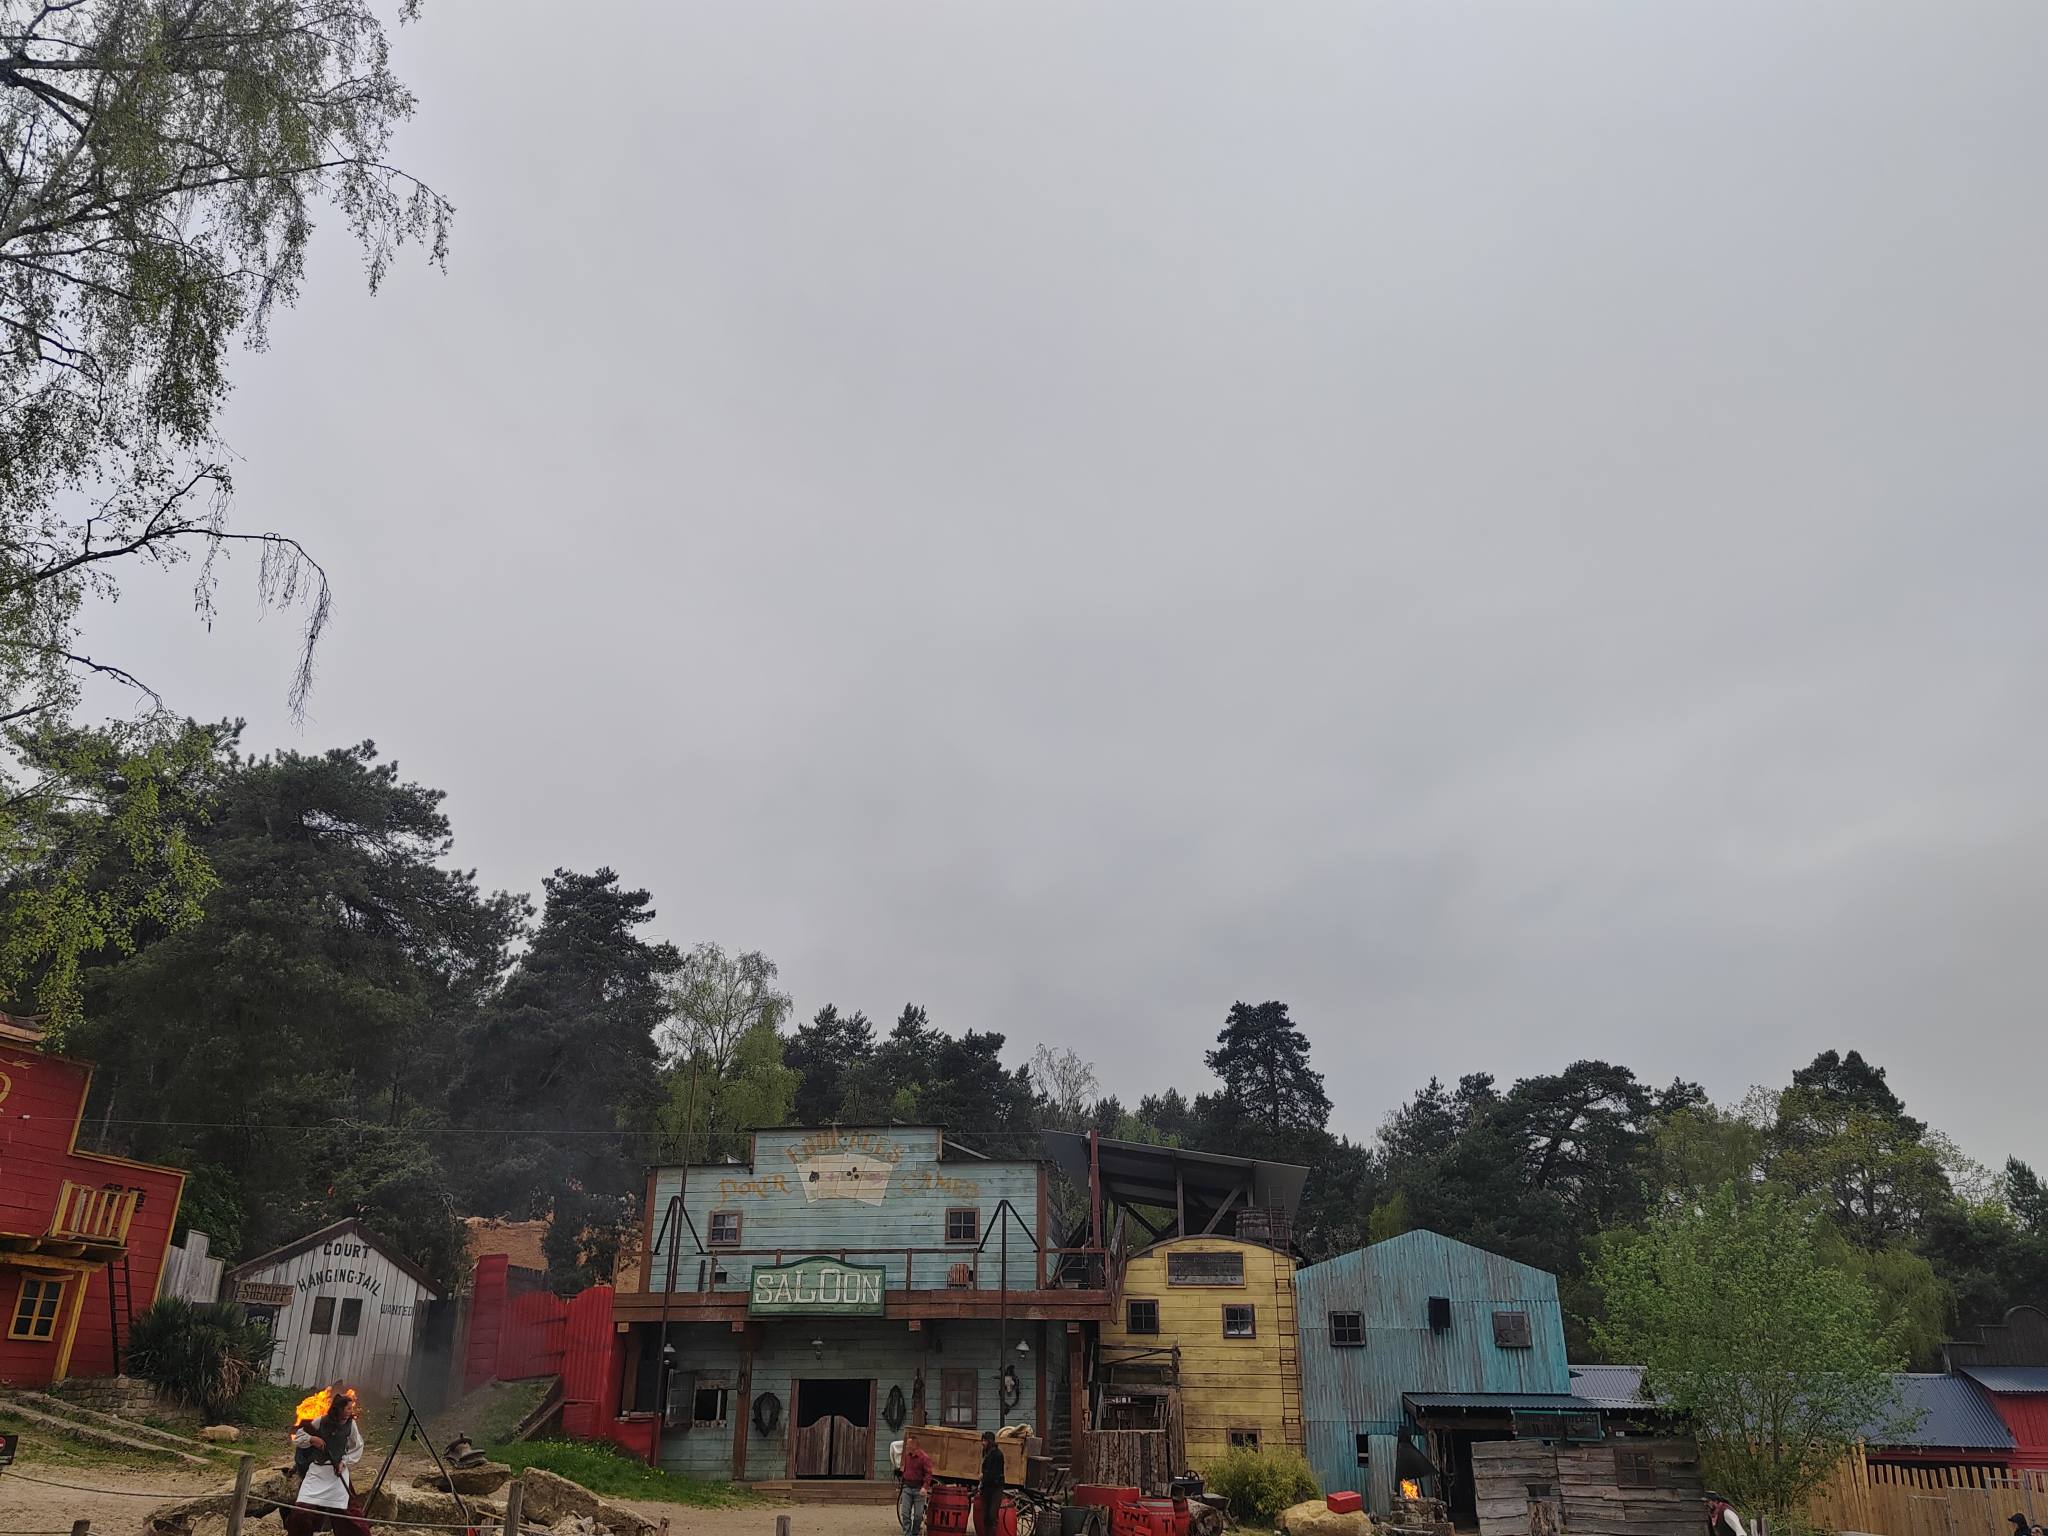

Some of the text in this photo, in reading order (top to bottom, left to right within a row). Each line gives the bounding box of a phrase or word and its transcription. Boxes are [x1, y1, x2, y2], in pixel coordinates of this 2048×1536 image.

[323, 1242, 372, 1258] COURT
[755, 1268, 880, 1304] SALOON
[381, 1304, 415, 1317] WANTED
[932, 1510, 961, 1527] TNT
[1123, 1512, 1148, 1523] TNT
